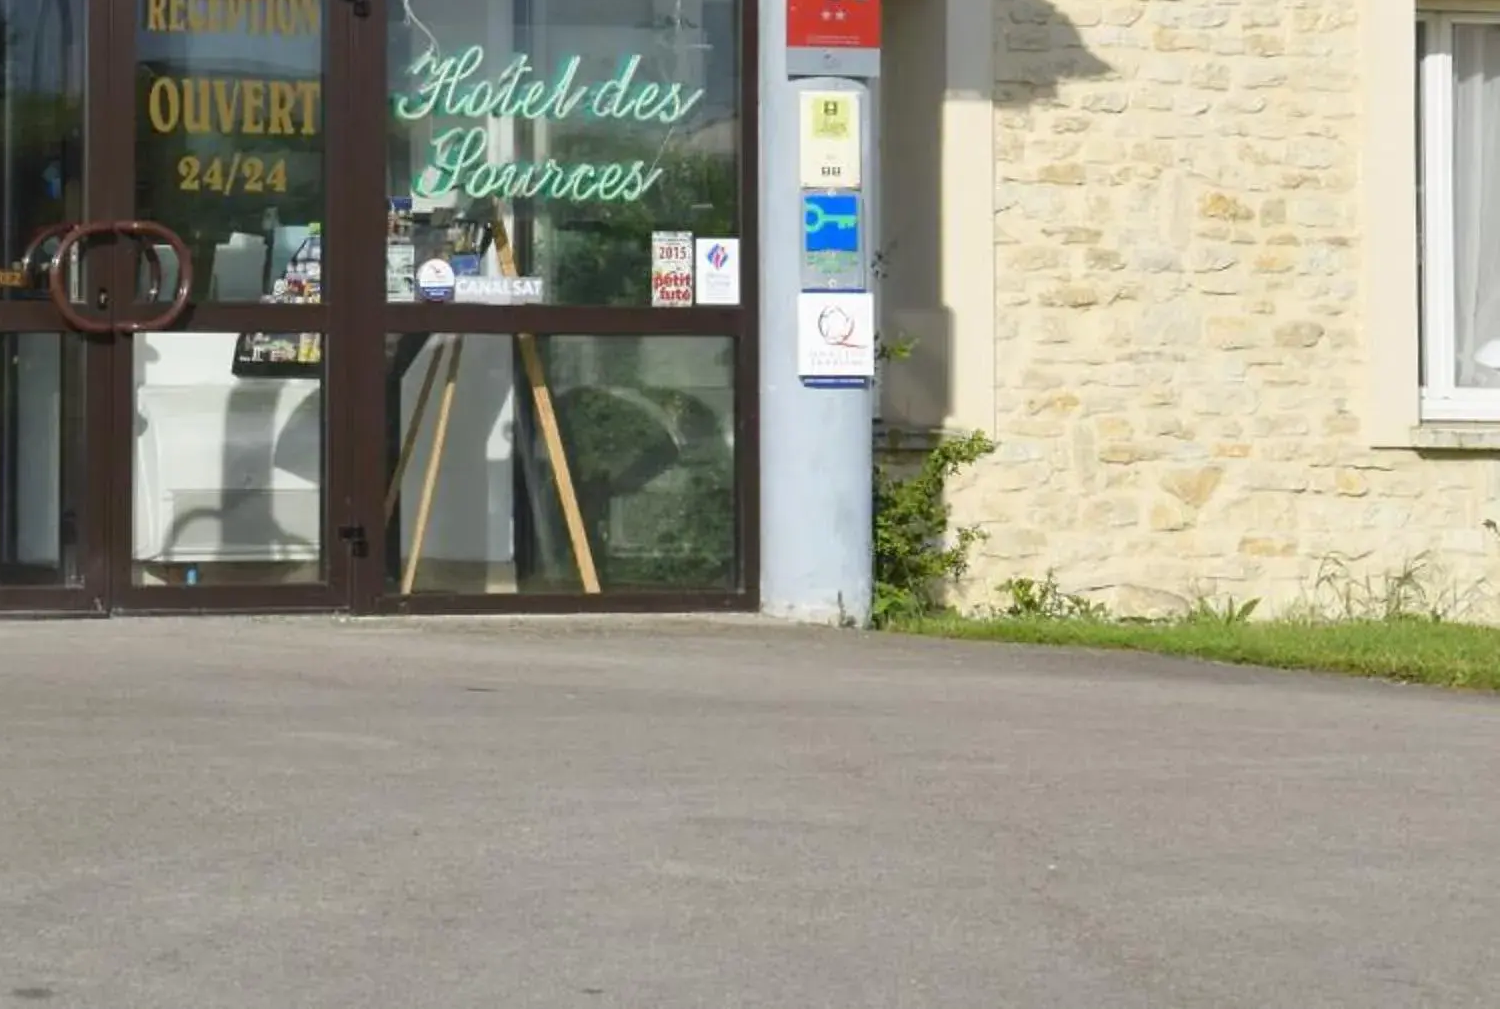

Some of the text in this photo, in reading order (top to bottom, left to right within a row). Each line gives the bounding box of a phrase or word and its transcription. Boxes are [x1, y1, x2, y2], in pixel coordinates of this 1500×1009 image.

[149, 76, 321, 135] OUVERT
[592, 54, 705, 123] des
[177, 152, 288, 196] 24/24
[418, 127, 663, 201] Sources
[659, 246, 687, 260] 2015
